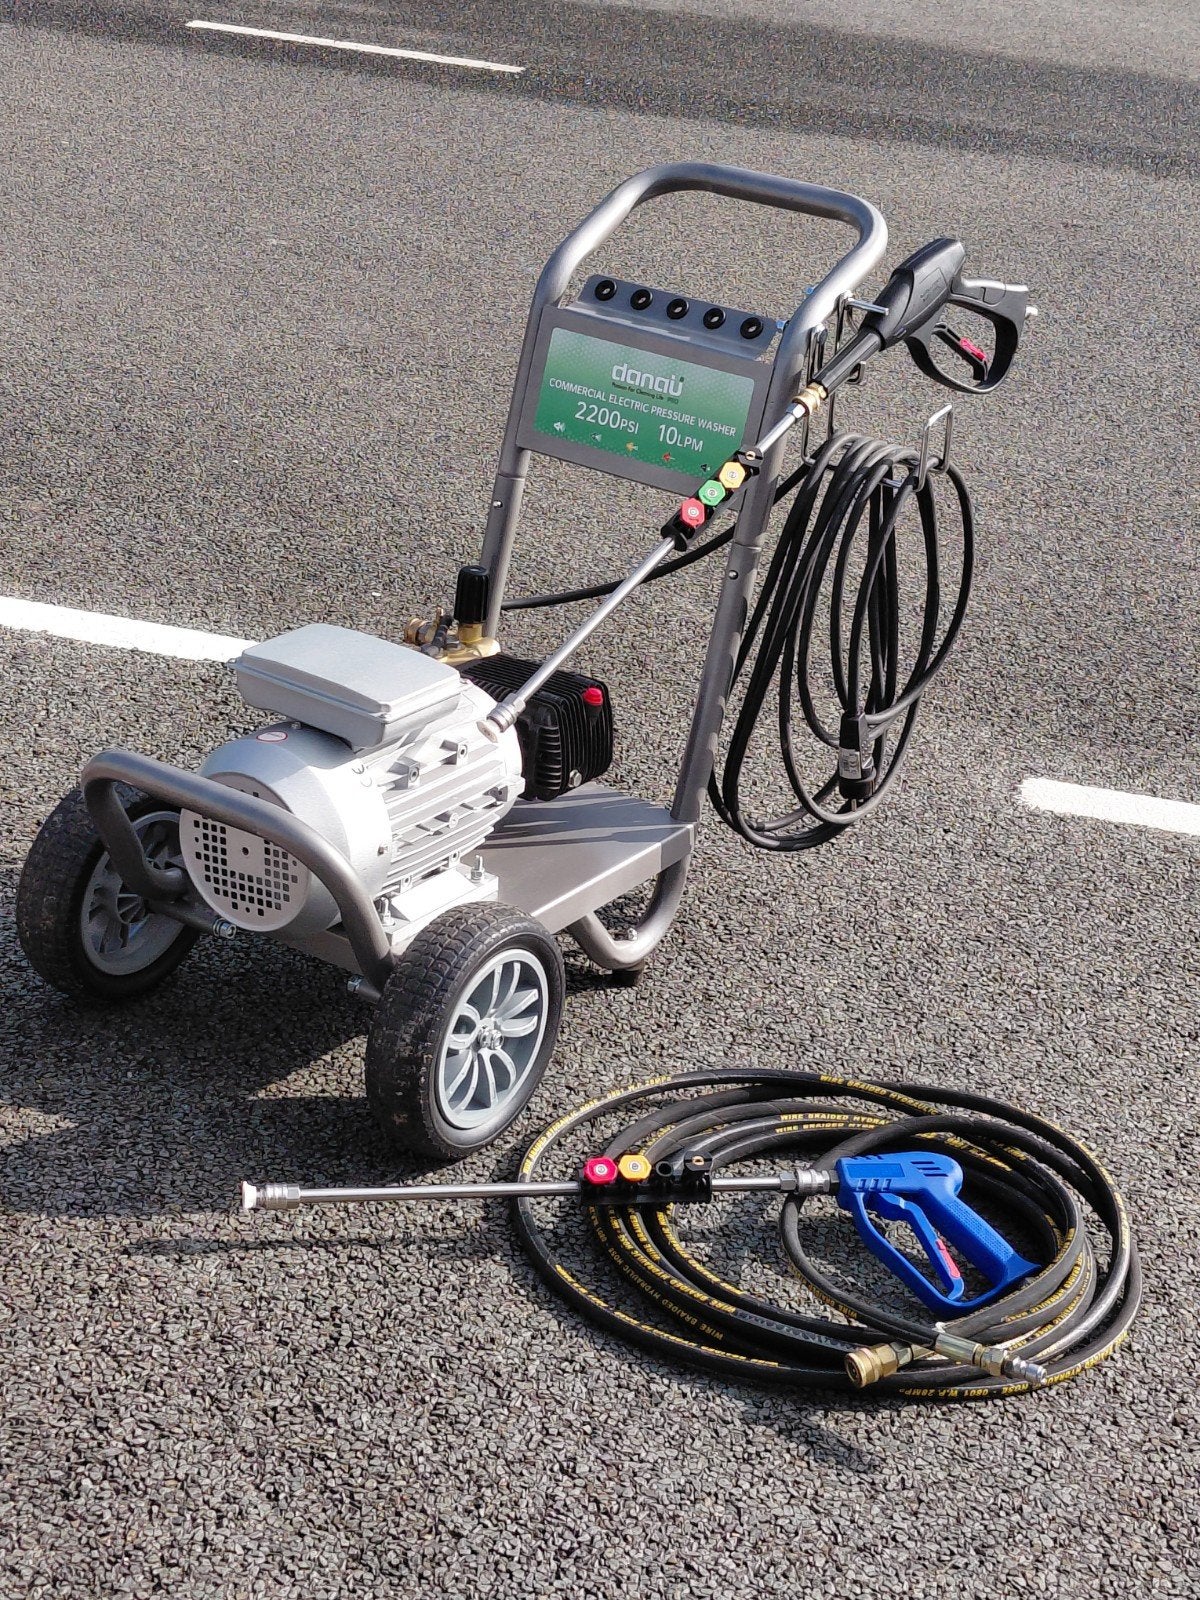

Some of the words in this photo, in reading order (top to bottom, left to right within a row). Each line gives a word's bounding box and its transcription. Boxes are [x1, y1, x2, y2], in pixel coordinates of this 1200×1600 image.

[549, 377, 607, 402] COMMERCIAL
[608, 393, 650, 413] ELECTRIC
[650, 405, 697, 426] PRESSURE
[697, 417, 737, 437] WASHER
[820, 1074, 845, 1085] WIRE
[846, 1080, 887, 1096] BRAIDED
[775, 1125, 799, 1134] WIRE
[803, 1122, 845, 1130] BRAIDED
[780, 1113, 804, 1122] WIRE
[808, 1113, 850, 1121] BRAIDED
[630, 1249, 672, 1281] HYDRAULIC
[622, 1265, 662, 1300] HYDRAULIC
[668, 1278, 709, 1303] BRAIDED
[661, 1298, 699, 1326] BRAIDED
[708, 1302, 738, 1314] WIRE
[700, 1321, 725, 1342] WIRE
[963, 1387, 989, 1397] 0801
